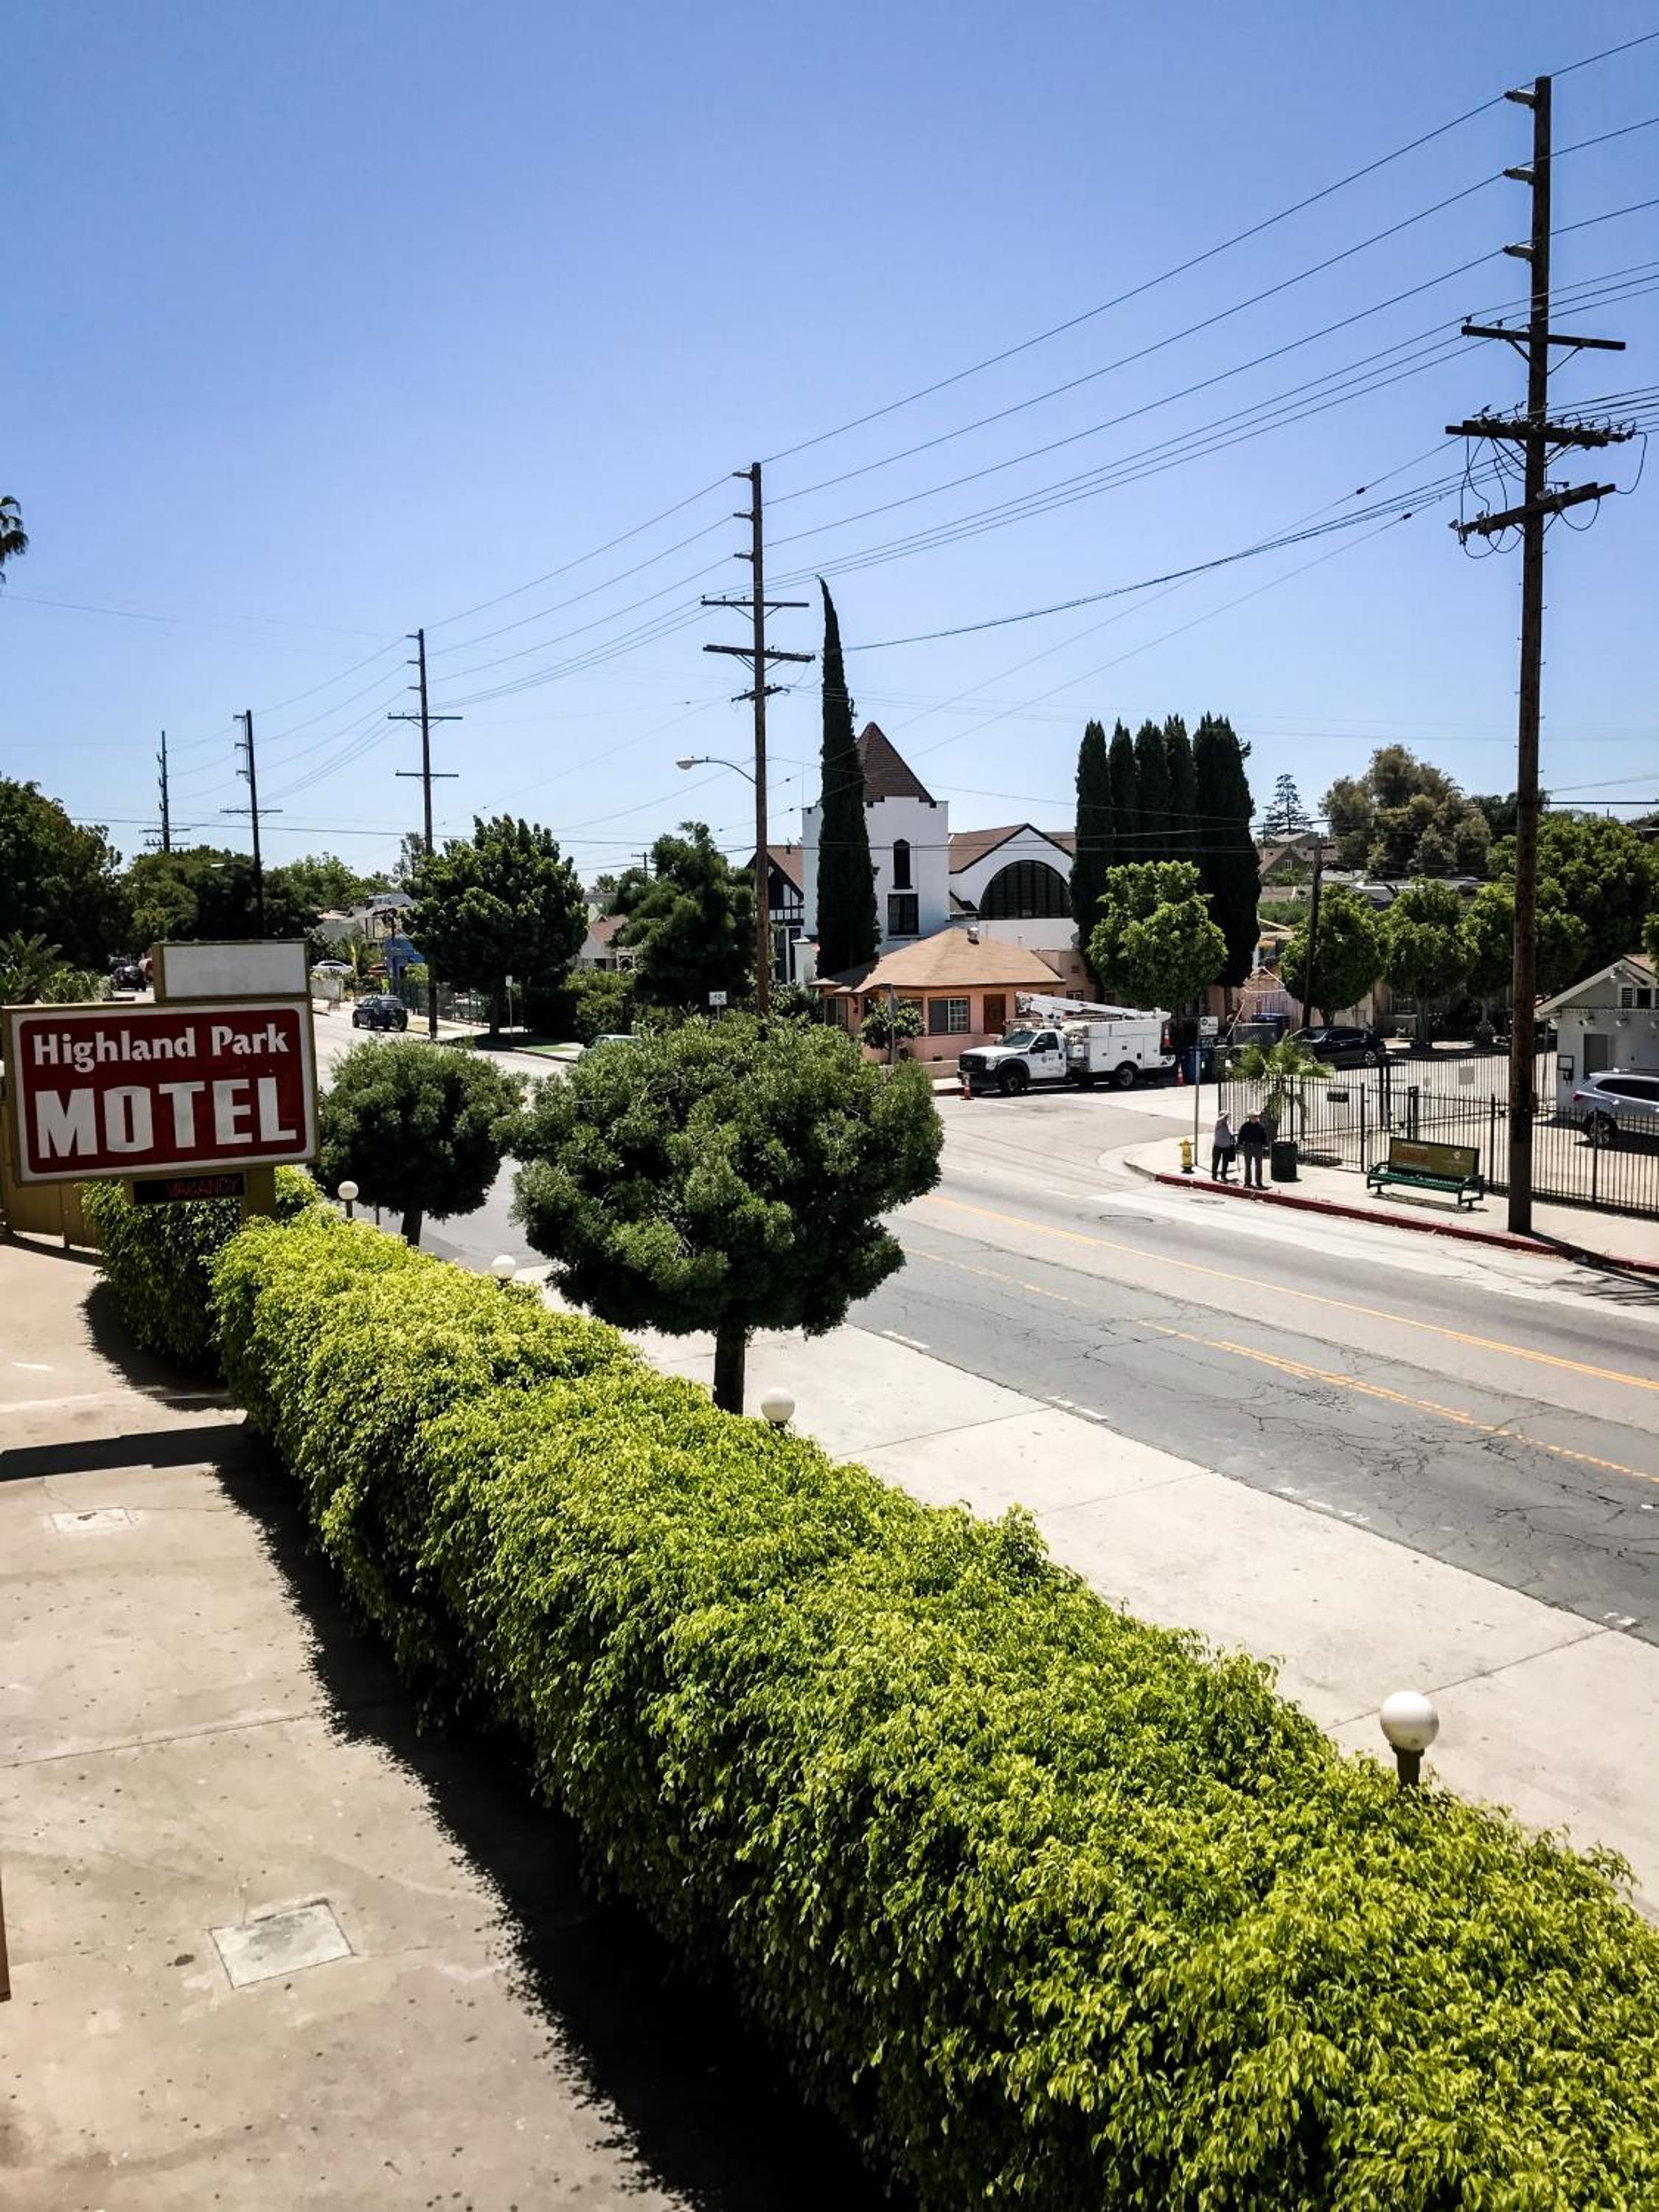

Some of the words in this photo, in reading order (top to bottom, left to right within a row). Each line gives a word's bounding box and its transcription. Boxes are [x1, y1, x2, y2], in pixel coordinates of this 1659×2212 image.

[33, 1027, 196, 1073] Highland
[212, 1023, 290, 1055] Park
[35, 1077, 296, 1159] MOTEL
